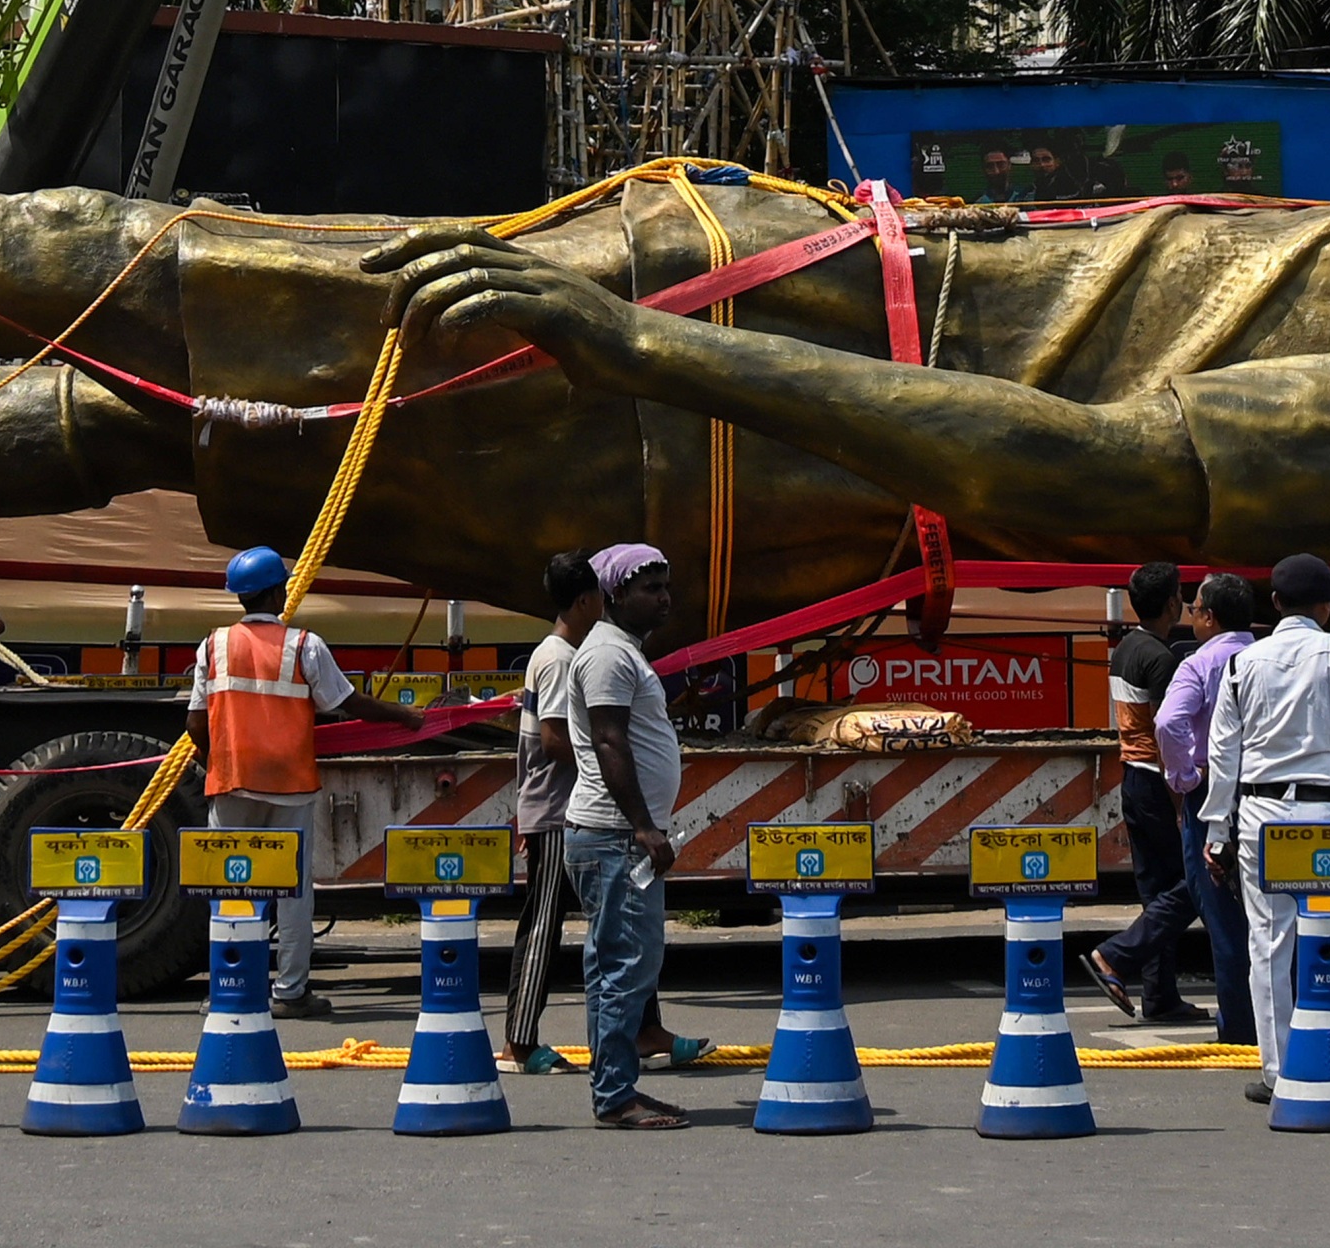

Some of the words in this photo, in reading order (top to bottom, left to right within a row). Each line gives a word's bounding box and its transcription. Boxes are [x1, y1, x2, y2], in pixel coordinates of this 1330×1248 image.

[886, 658, 1043, 686] PRITAM
[886, 692, 927, 703] SWITCH
[931, 692, 948, 701] ON
[951, 691, 970, 701] THE
[974, 690, 1007, 700] GOOD
[1011, 689, 1044, 700] TIMES
[403, 833, 453, 850] यूको
[753, 827, 819, 847] ইউকো
[976, 831, 1043, 850] ইউকো
[1270, 829, 1314, 840] UCO
[194, 835, 241, 853] यूको
[246, 836, 285, 850] बैंक
[1271, 882, 1318, 890] HONOURS
